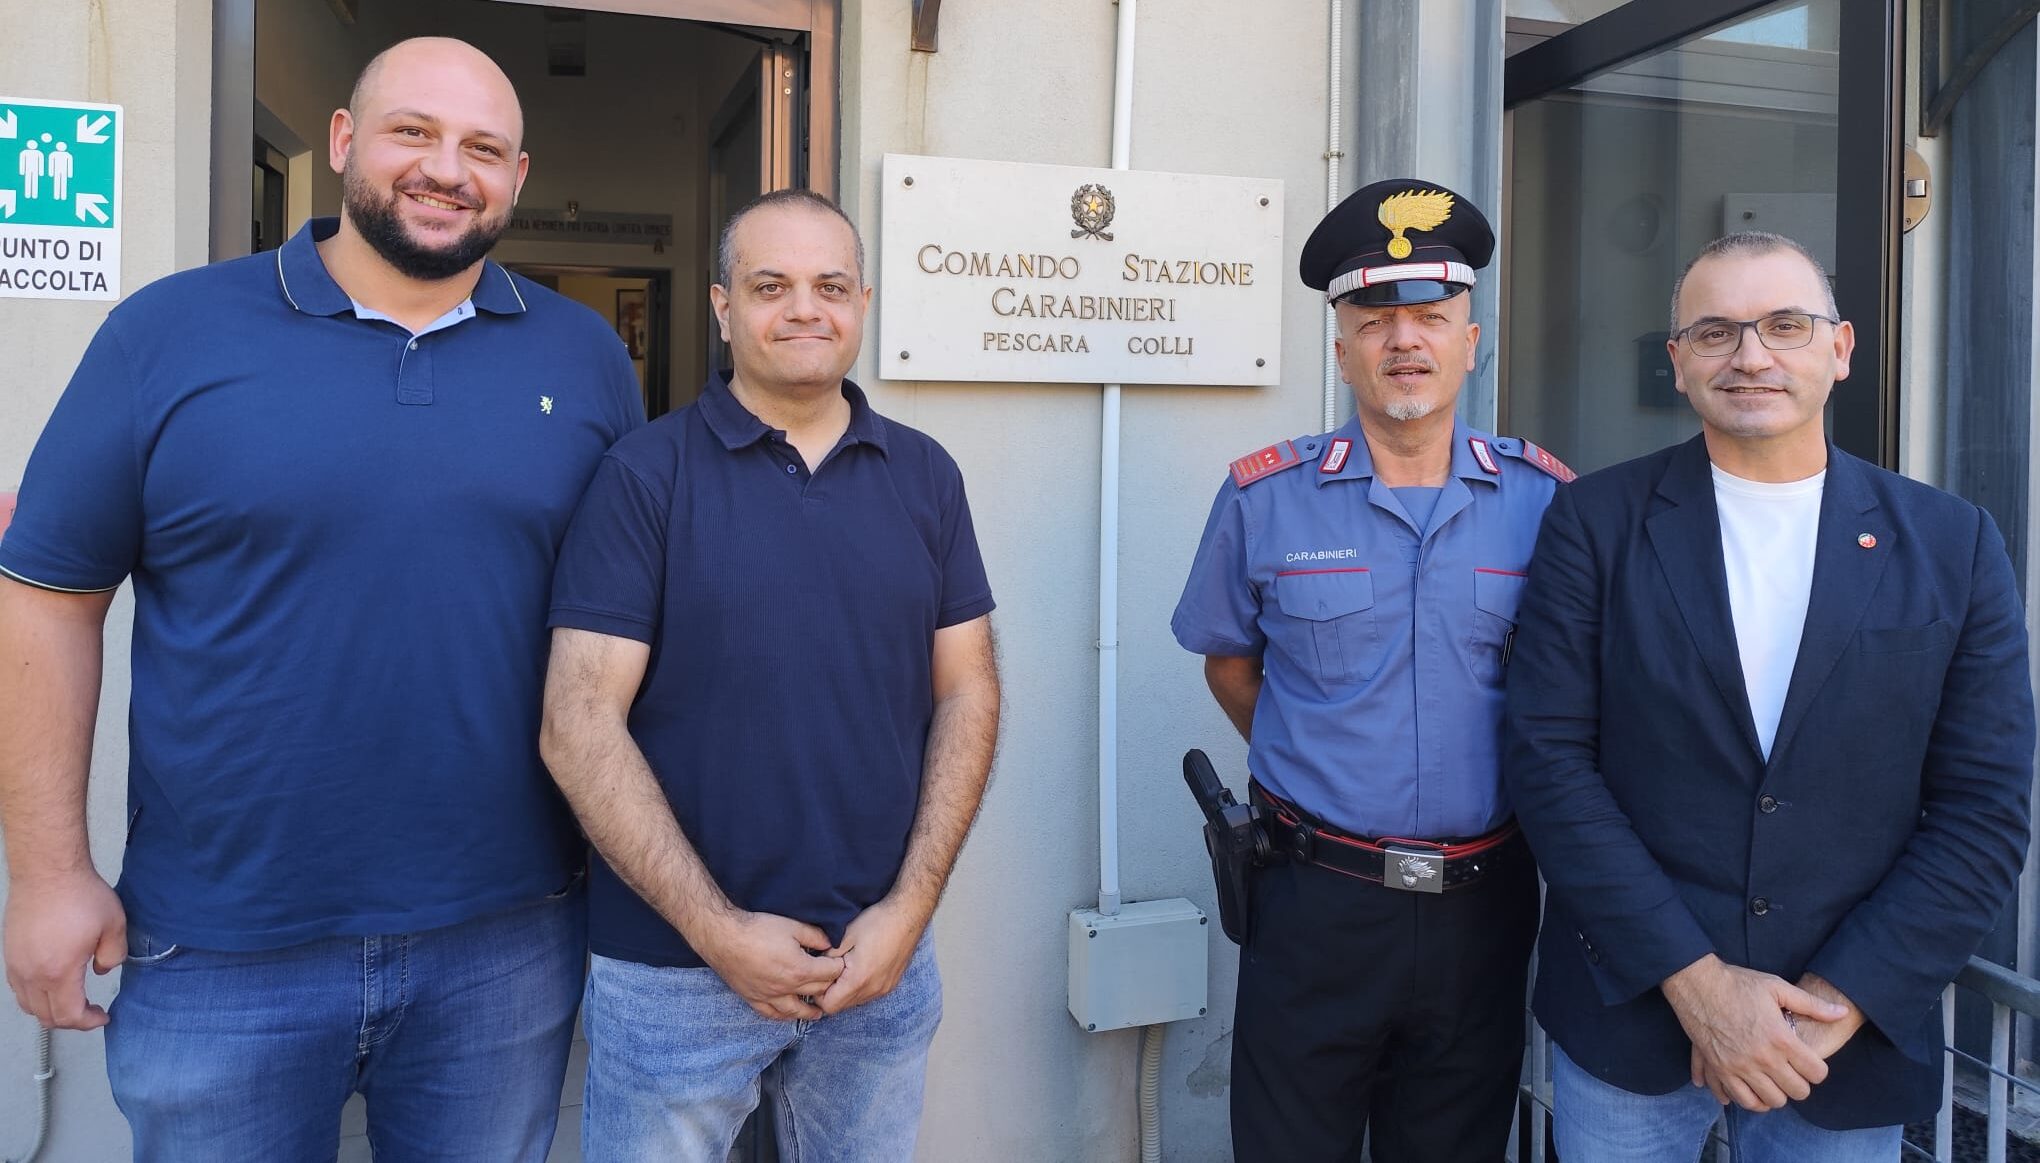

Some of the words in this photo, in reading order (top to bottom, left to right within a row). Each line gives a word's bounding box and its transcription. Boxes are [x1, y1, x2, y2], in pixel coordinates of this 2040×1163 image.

[0, 237, 70, 260] UNTO
[79, 240, 102, 262] DI
[917, 243, 1080, 279] COMANDO
[1122, 253, 1254, 286] STAZIONE
[0, 268, 108, 292] ACCOLTA
[991, 286, 1177, 322] CARABINIERI
[982, 331, 1090, 353] PESCARA
[1127, 336, 1194, 355] COLLI
[1286, 548, 1357, 562] CARABINIERI
